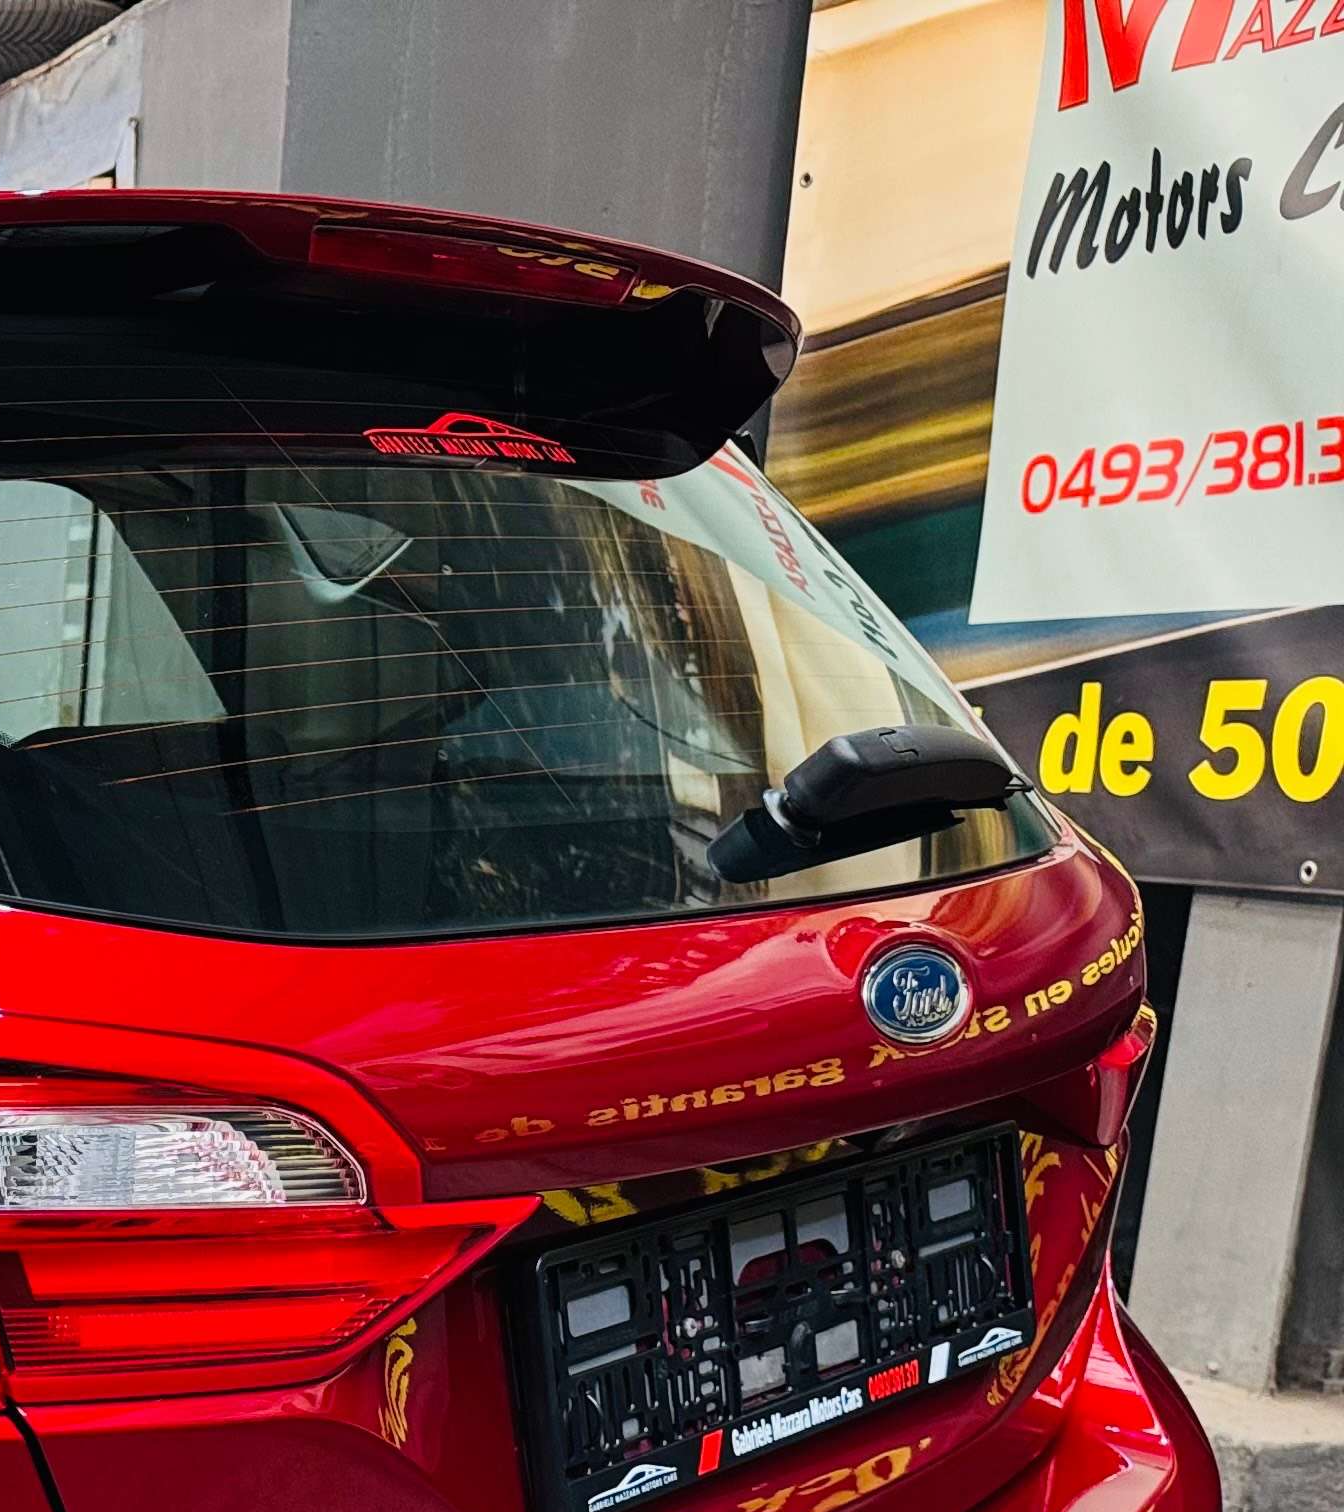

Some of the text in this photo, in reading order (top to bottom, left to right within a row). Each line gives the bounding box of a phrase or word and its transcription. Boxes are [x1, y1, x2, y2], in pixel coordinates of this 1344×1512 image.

[1026, 147, 1252, 279] Motors
[1038, 675, 1344, 803] de 50
[892, 964, 953, 1022] Ford
[731, 1418, 773, 1457] Gabriele
[840, 1386, 864, 1414] Cars
